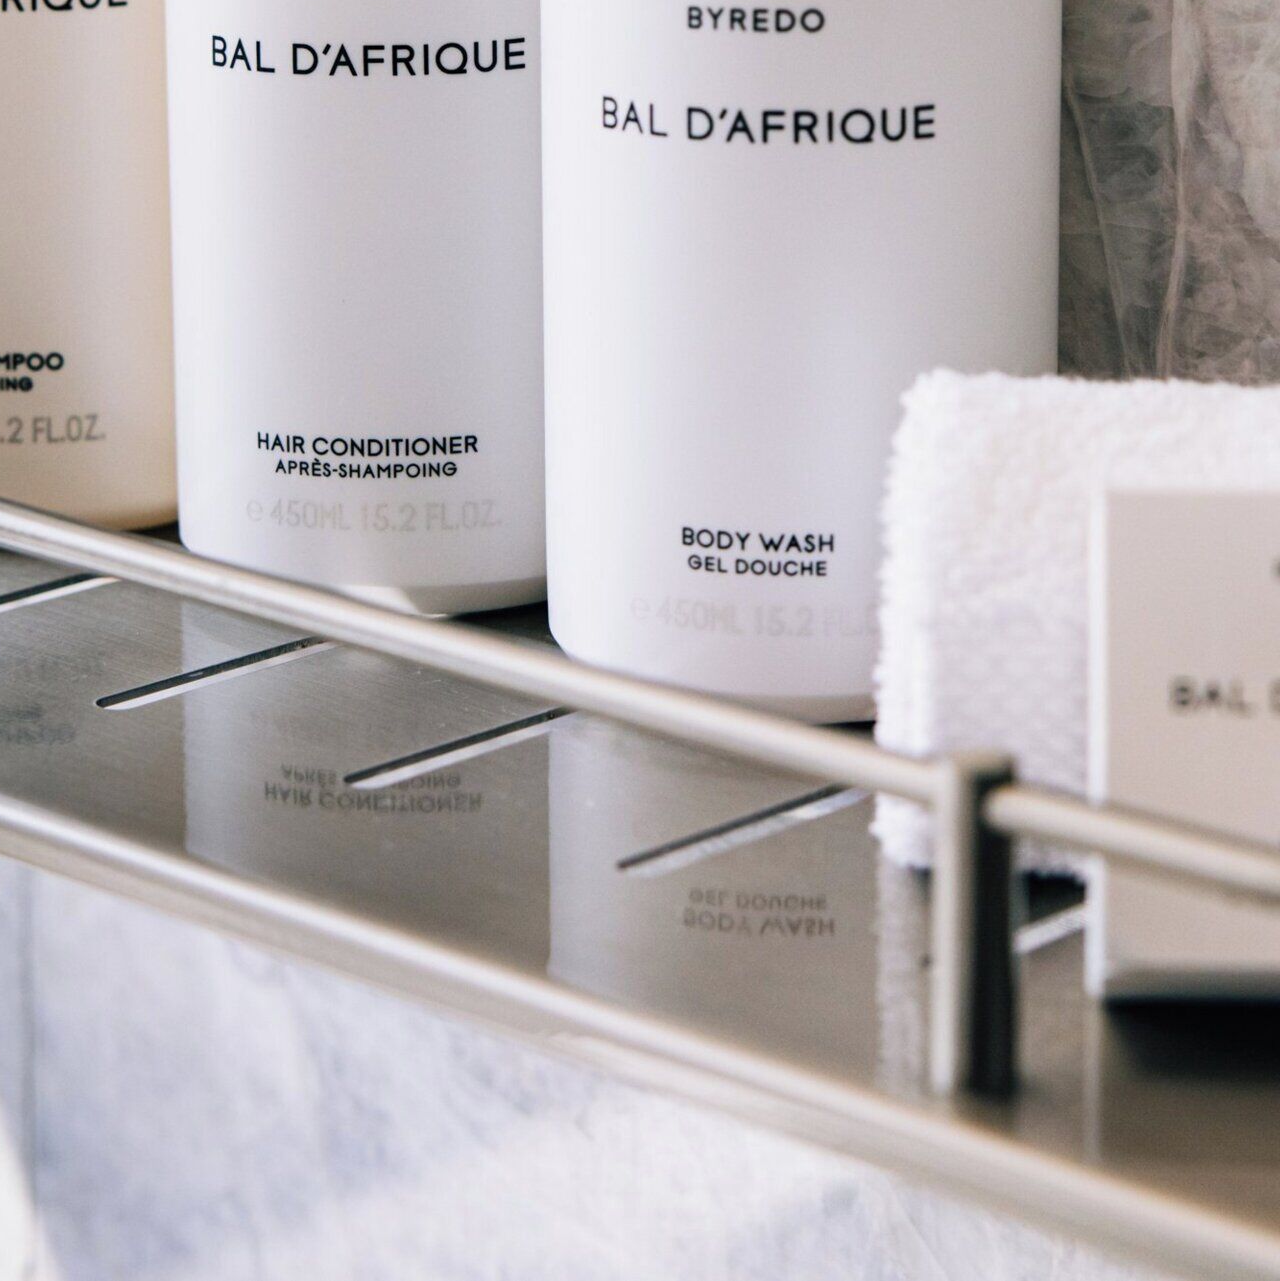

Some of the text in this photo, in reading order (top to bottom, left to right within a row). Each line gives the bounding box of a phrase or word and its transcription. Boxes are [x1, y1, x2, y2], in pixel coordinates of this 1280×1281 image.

[687, 5, 826, 33] BYREDO
[211, 34, 526, 77] BAL D'AFRIQUE
[602, 95, 936, 144] BAL D'AFRIQUE
[256, 431, 479, 458] HAIR CONDITIONER
[275, 457, 458, 479] APRÈS-SHAMPOING
[360, 501, 418, 533] 15.2
[681, 526, 835, 553] BODY WASH
[687, 554, 828, 577] GEL DOUCHE
[1170, 675, 1254, 717] BAL
